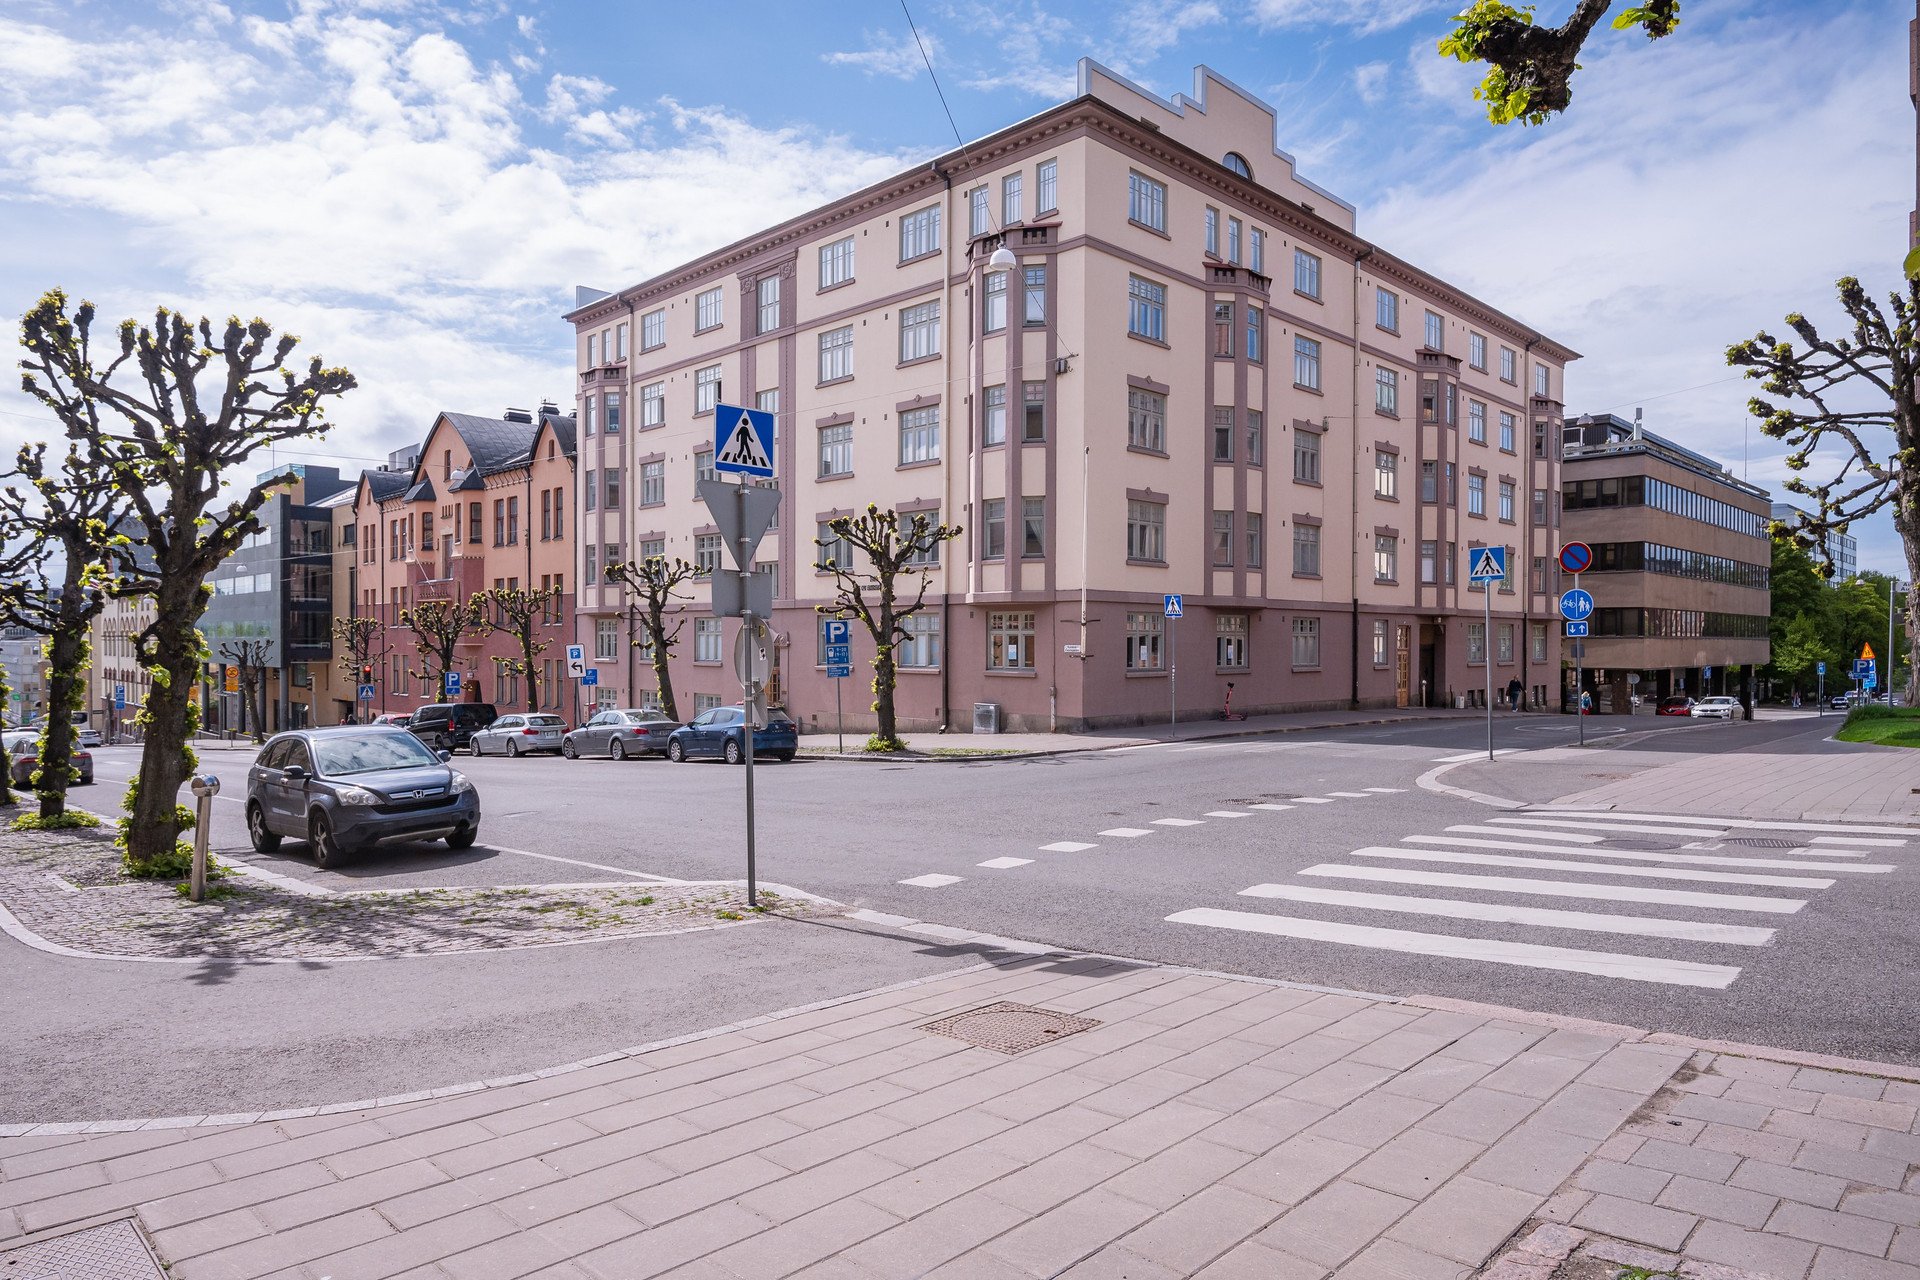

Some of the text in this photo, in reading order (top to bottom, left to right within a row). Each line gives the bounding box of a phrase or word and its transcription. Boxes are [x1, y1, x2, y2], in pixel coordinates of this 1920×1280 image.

[830, 622, 845, 643] P
[1857, 660, 1868, 673] P
[448, 673, 459, 686] P
